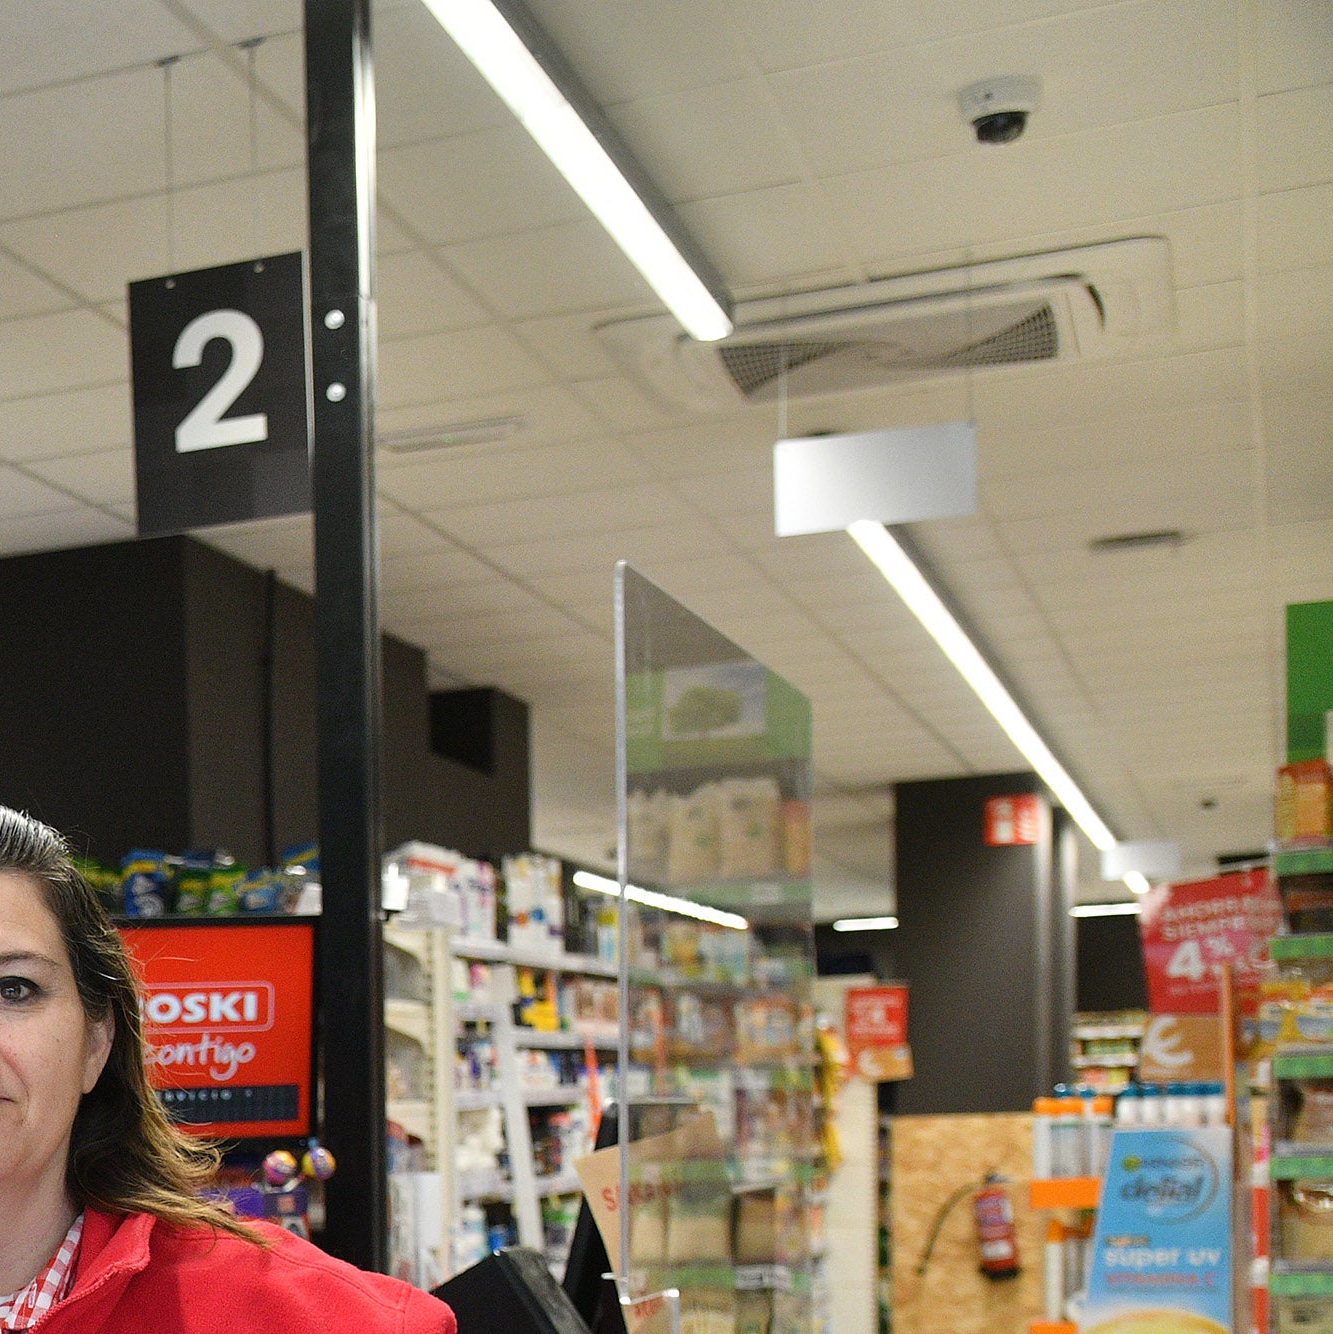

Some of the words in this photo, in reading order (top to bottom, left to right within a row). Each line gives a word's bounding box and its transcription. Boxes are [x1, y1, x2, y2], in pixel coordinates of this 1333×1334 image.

[171, 308, 268, 453] 2
[139, 991, 259, 1024] OSKI
[1104, 1247, 1181, 1271] super
